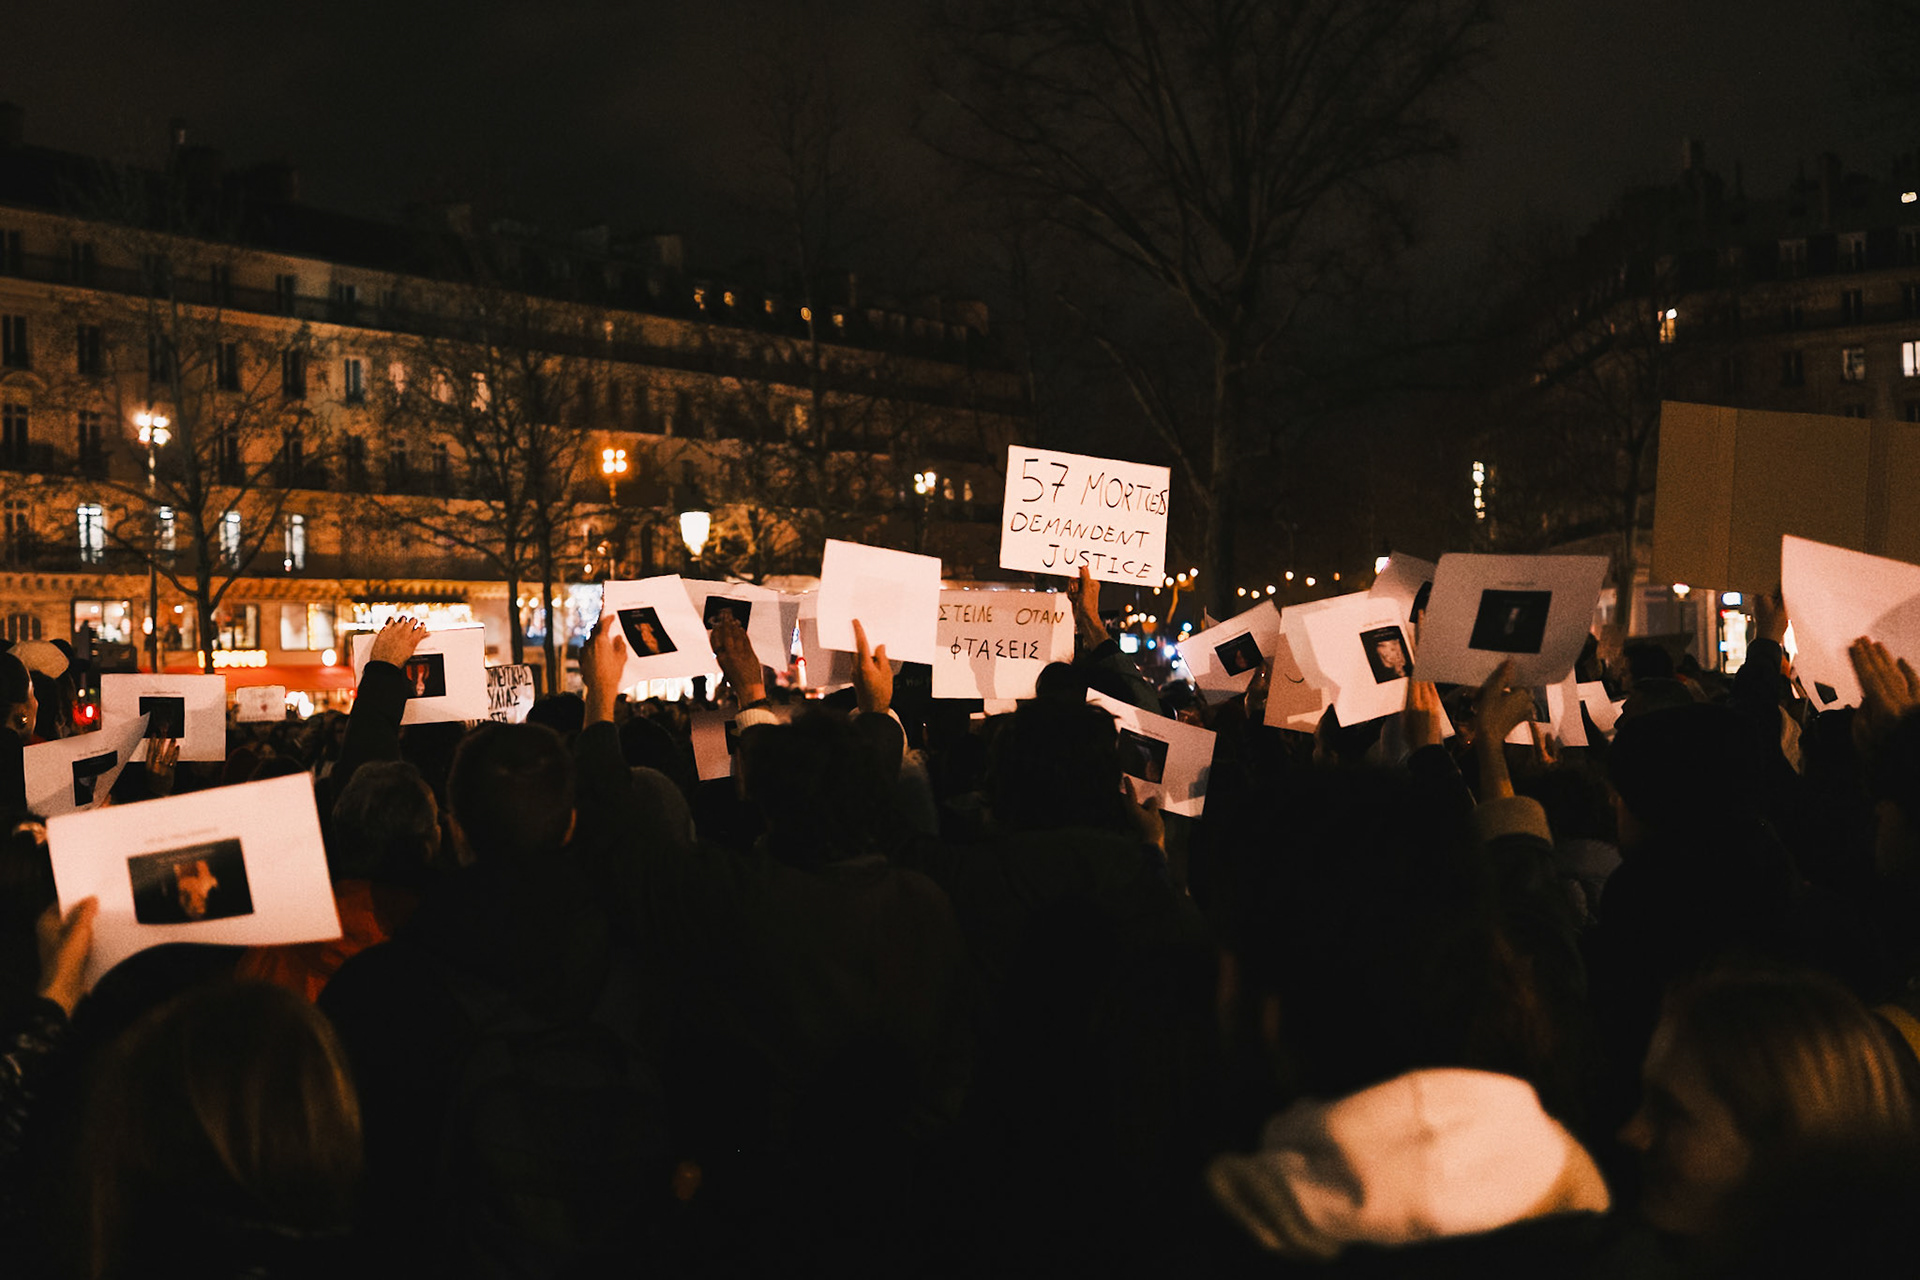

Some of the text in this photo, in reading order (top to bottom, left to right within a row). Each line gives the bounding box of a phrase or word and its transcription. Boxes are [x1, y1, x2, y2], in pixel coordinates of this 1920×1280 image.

[1022, 458, 1069, 503] 57
[1010, 512, 1150, 548] DEMANDENT
[1042, 544, 1153, 579] JUSTICE
[938, 604, 1065, 625] ΣΤΕΙΛΕ ΟΤΑΝ
